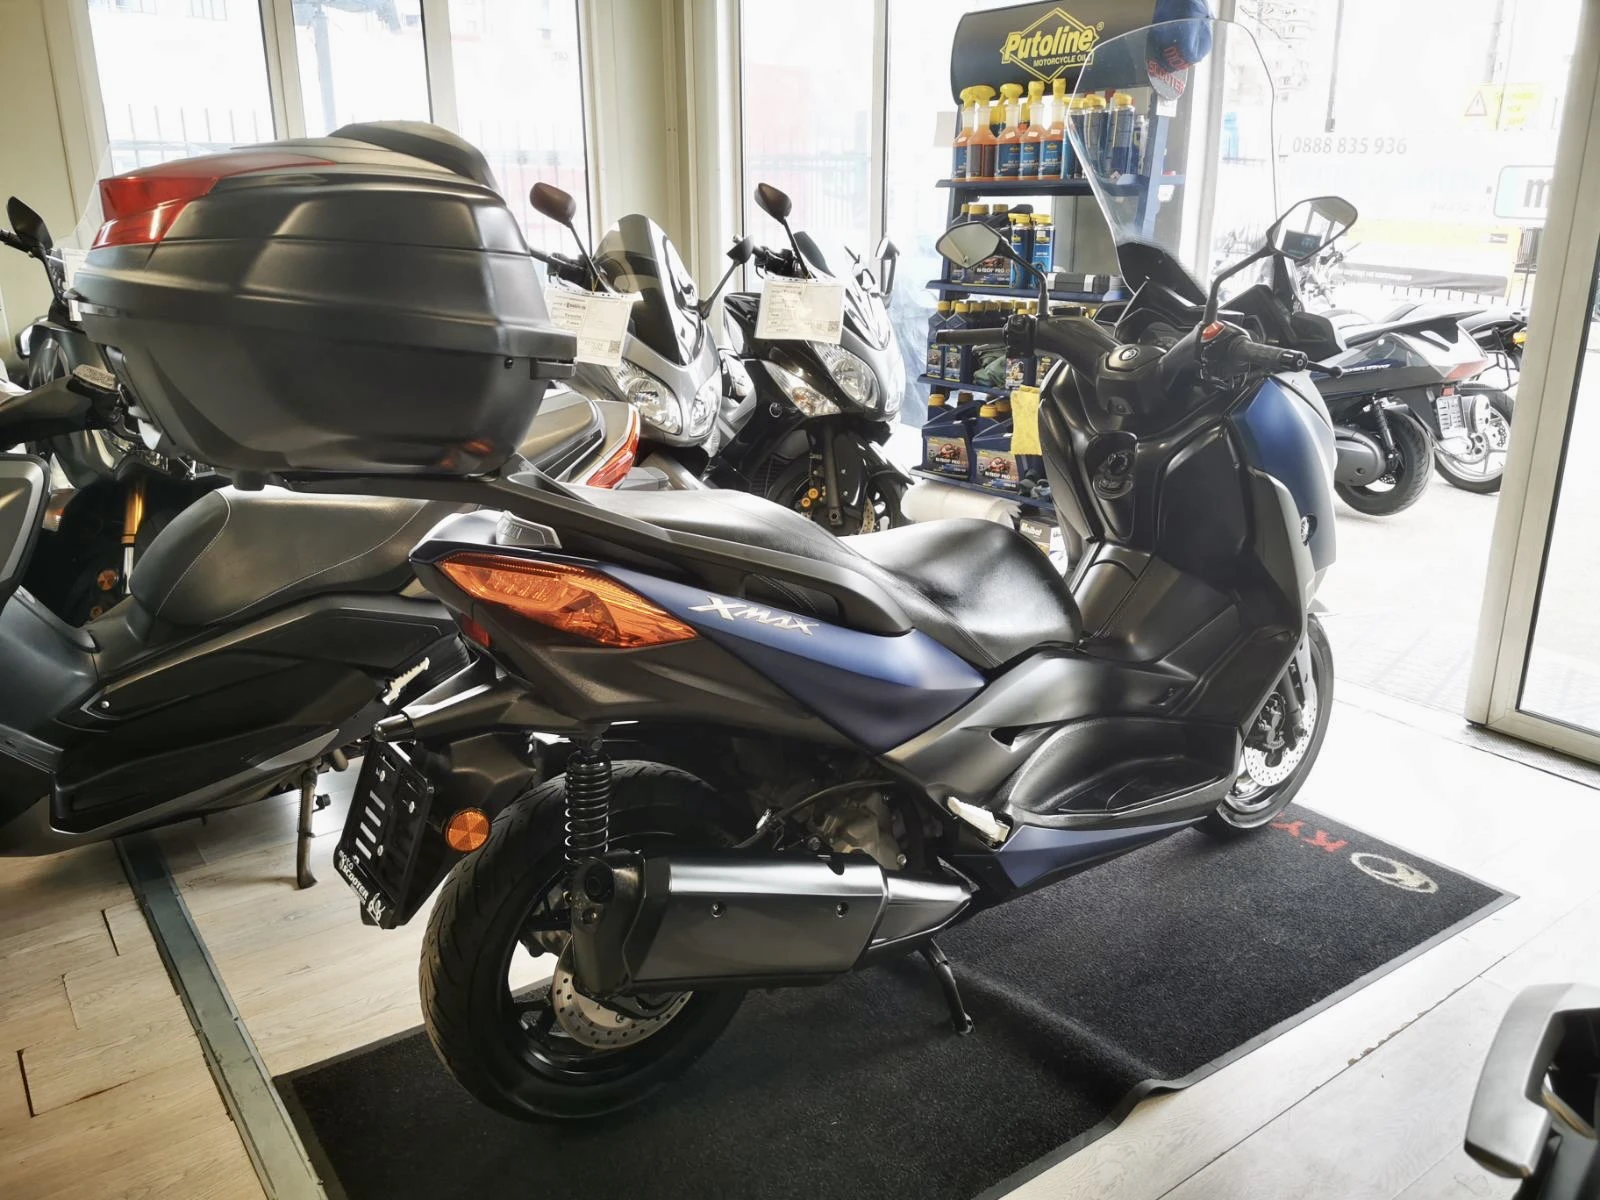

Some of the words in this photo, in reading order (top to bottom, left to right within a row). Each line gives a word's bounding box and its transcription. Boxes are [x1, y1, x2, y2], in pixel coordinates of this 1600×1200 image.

[1004, 26, 1094, 61] Putoline
[1033, 54, 1076, 67] MOTORCYCLE
[1293, 136, 1332, 154] 0888
[1337, 136, 1369, 154] 835
[1374, 136, 1408, 154] 936
